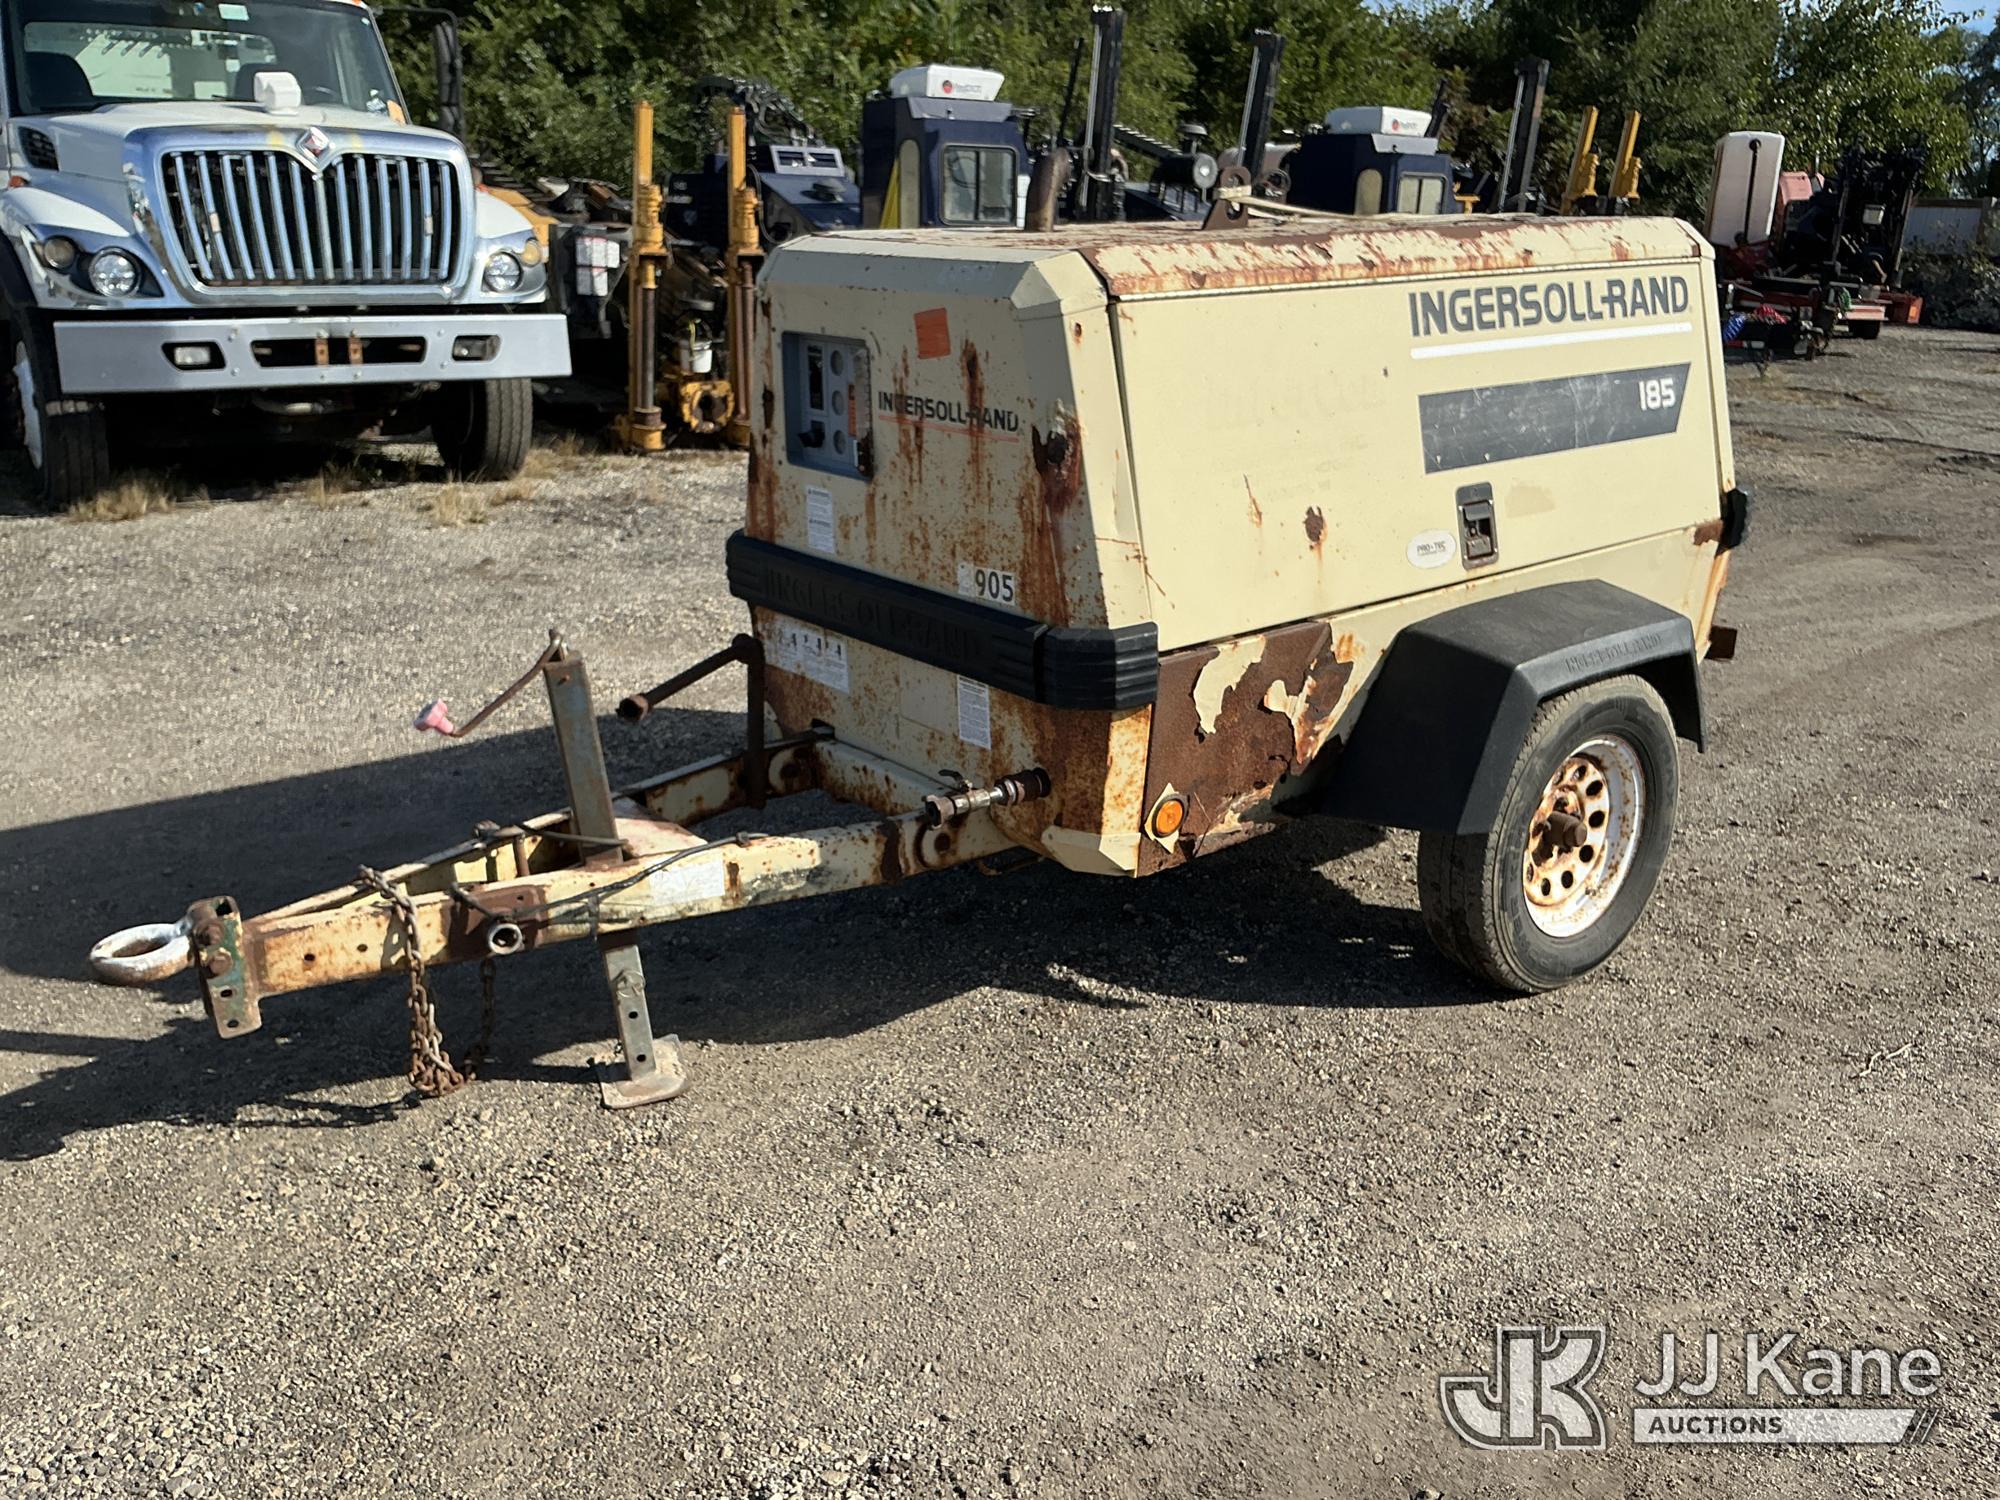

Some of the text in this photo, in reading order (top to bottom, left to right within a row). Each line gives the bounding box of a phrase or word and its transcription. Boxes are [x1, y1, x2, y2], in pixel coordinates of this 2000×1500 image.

[1408, 275, 1689, 337] INGERSOLL-RAND
[1638, 377, 1676, 411] 185
[975, 569, 1014, 602] 905
